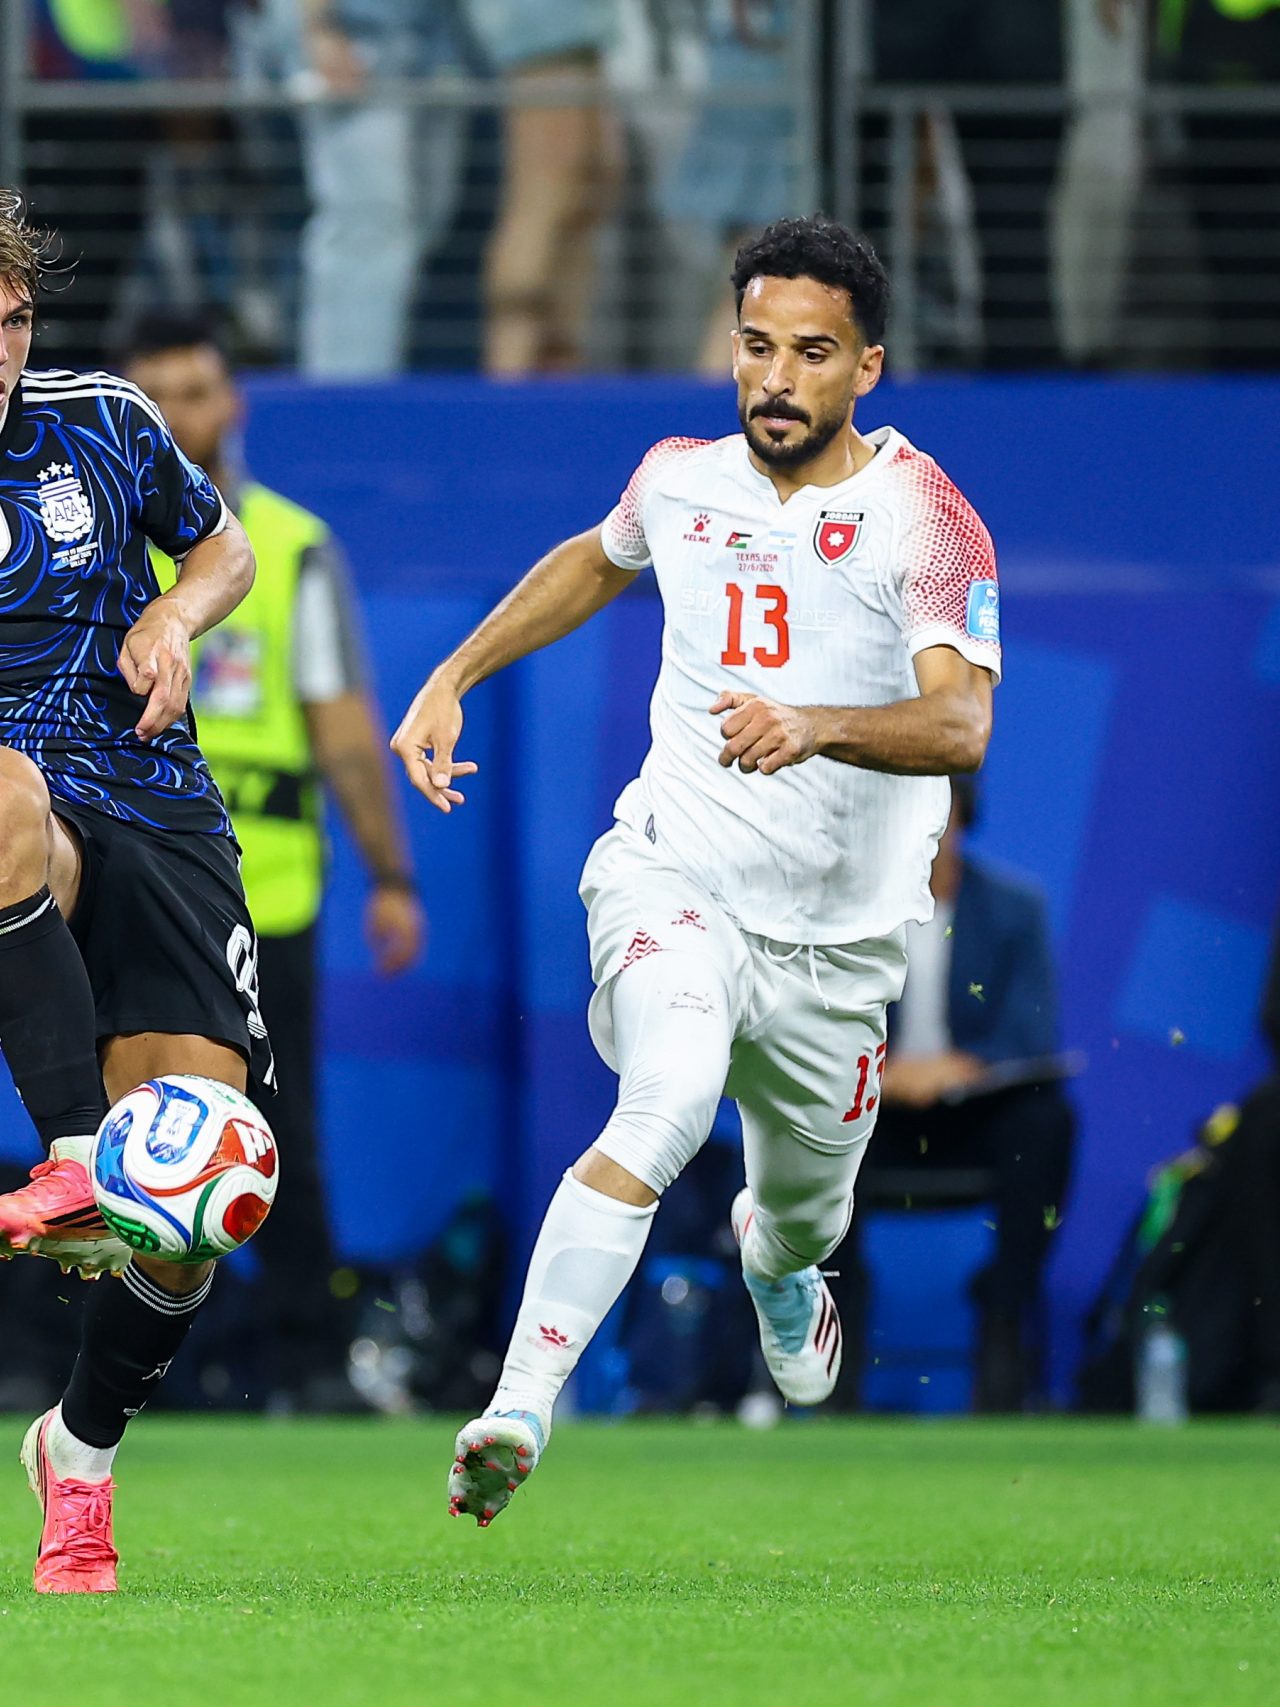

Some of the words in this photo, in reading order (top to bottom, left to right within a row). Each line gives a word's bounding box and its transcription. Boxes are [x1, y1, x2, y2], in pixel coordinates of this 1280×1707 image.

[54, 497, 81, 522] AFA
[824, 511, 860, 521] JORDAN
[683, 533, 711, 544] KELME
[762, 553, 778, 562] USA
[721, 583, 790, 668] 13
